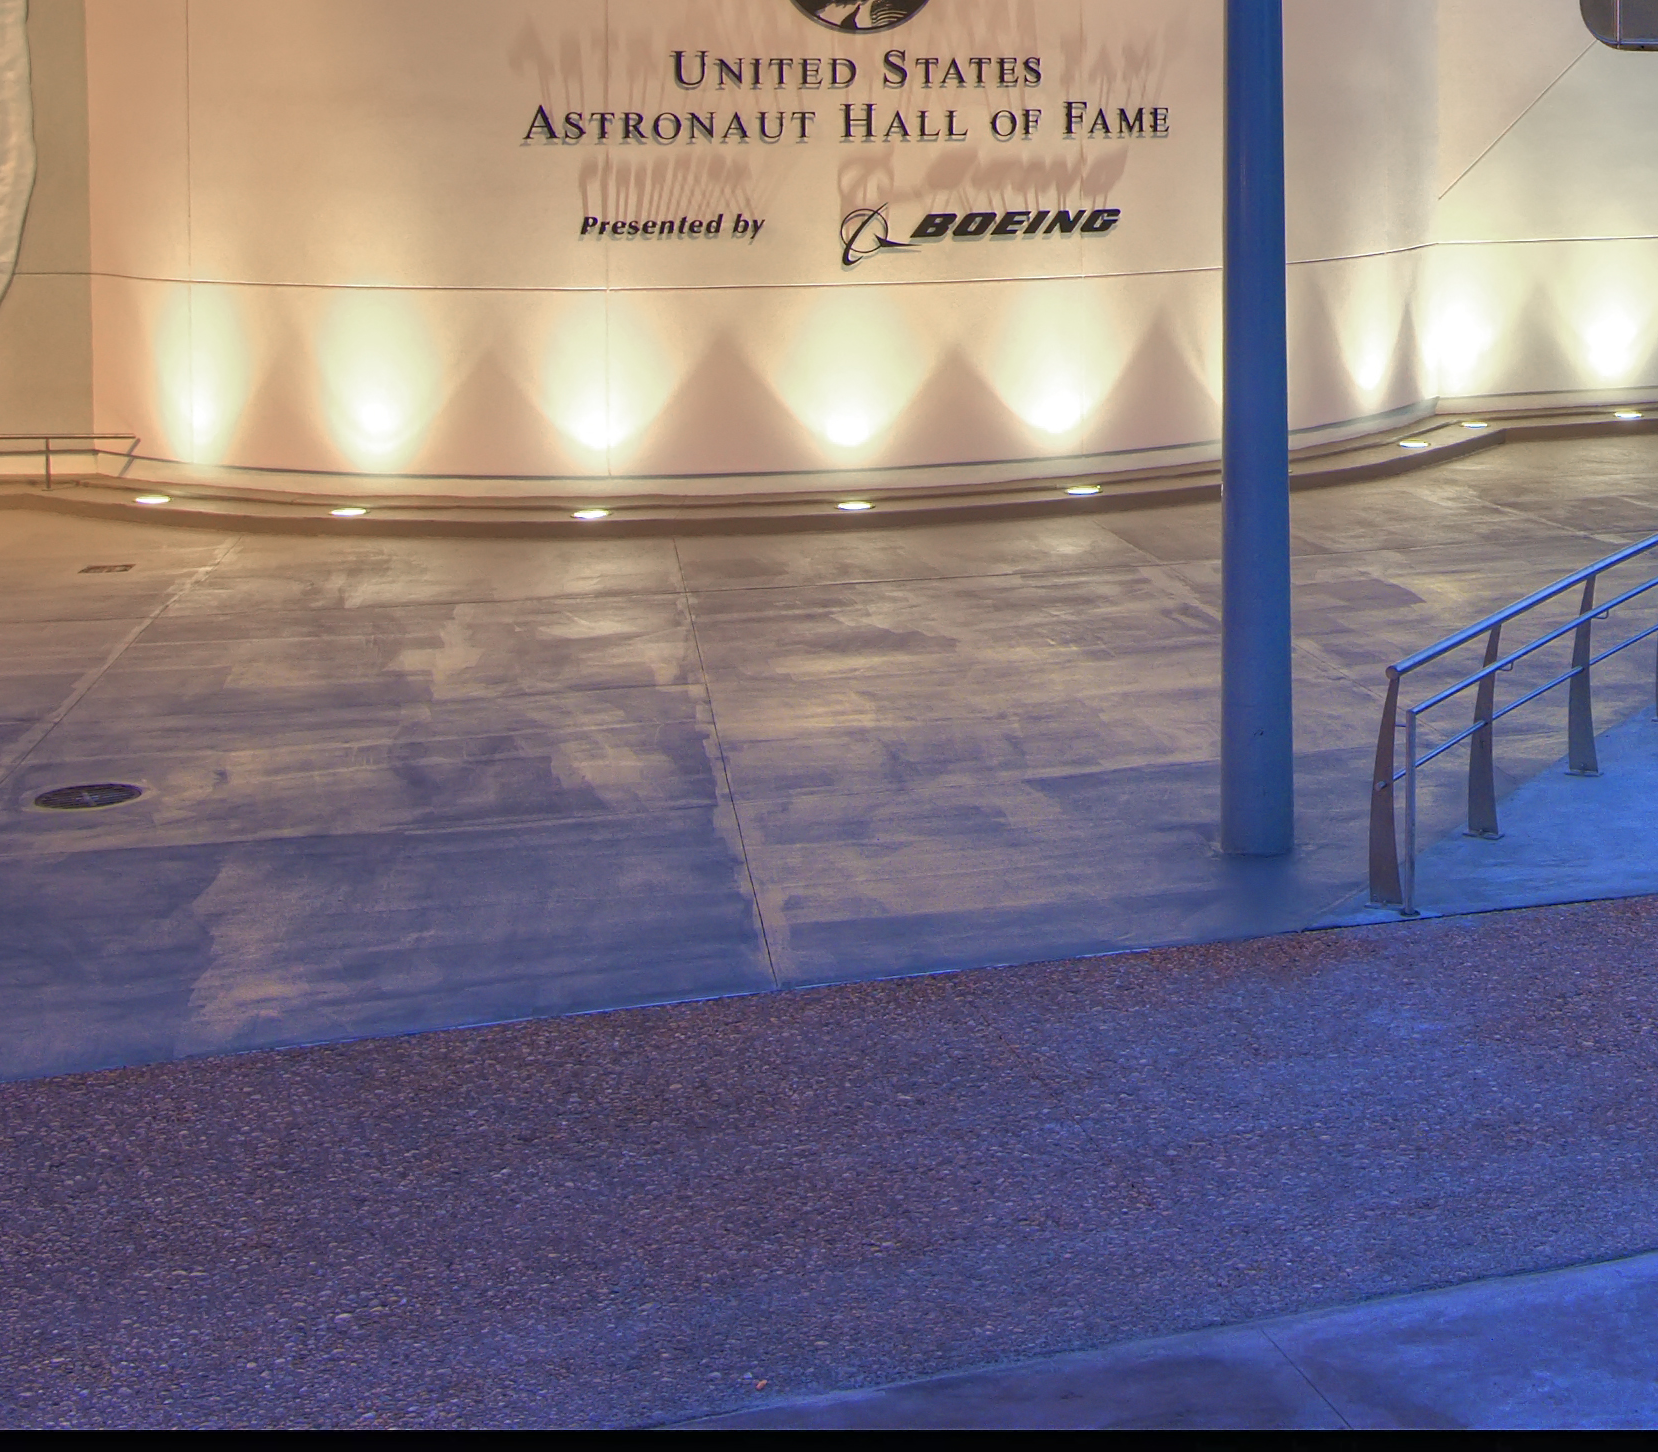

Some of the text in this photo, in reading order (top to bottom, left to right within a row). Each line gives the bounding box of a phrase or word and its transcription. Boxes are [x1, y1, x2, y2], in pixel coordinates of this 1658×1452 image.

[671, 48, 1043, 87] UNITED STATES
[522, 100, 1171, 142] ASTRONAUT HALL OF FAME
[580, 208, 1122, 244] Presented by BOEING
